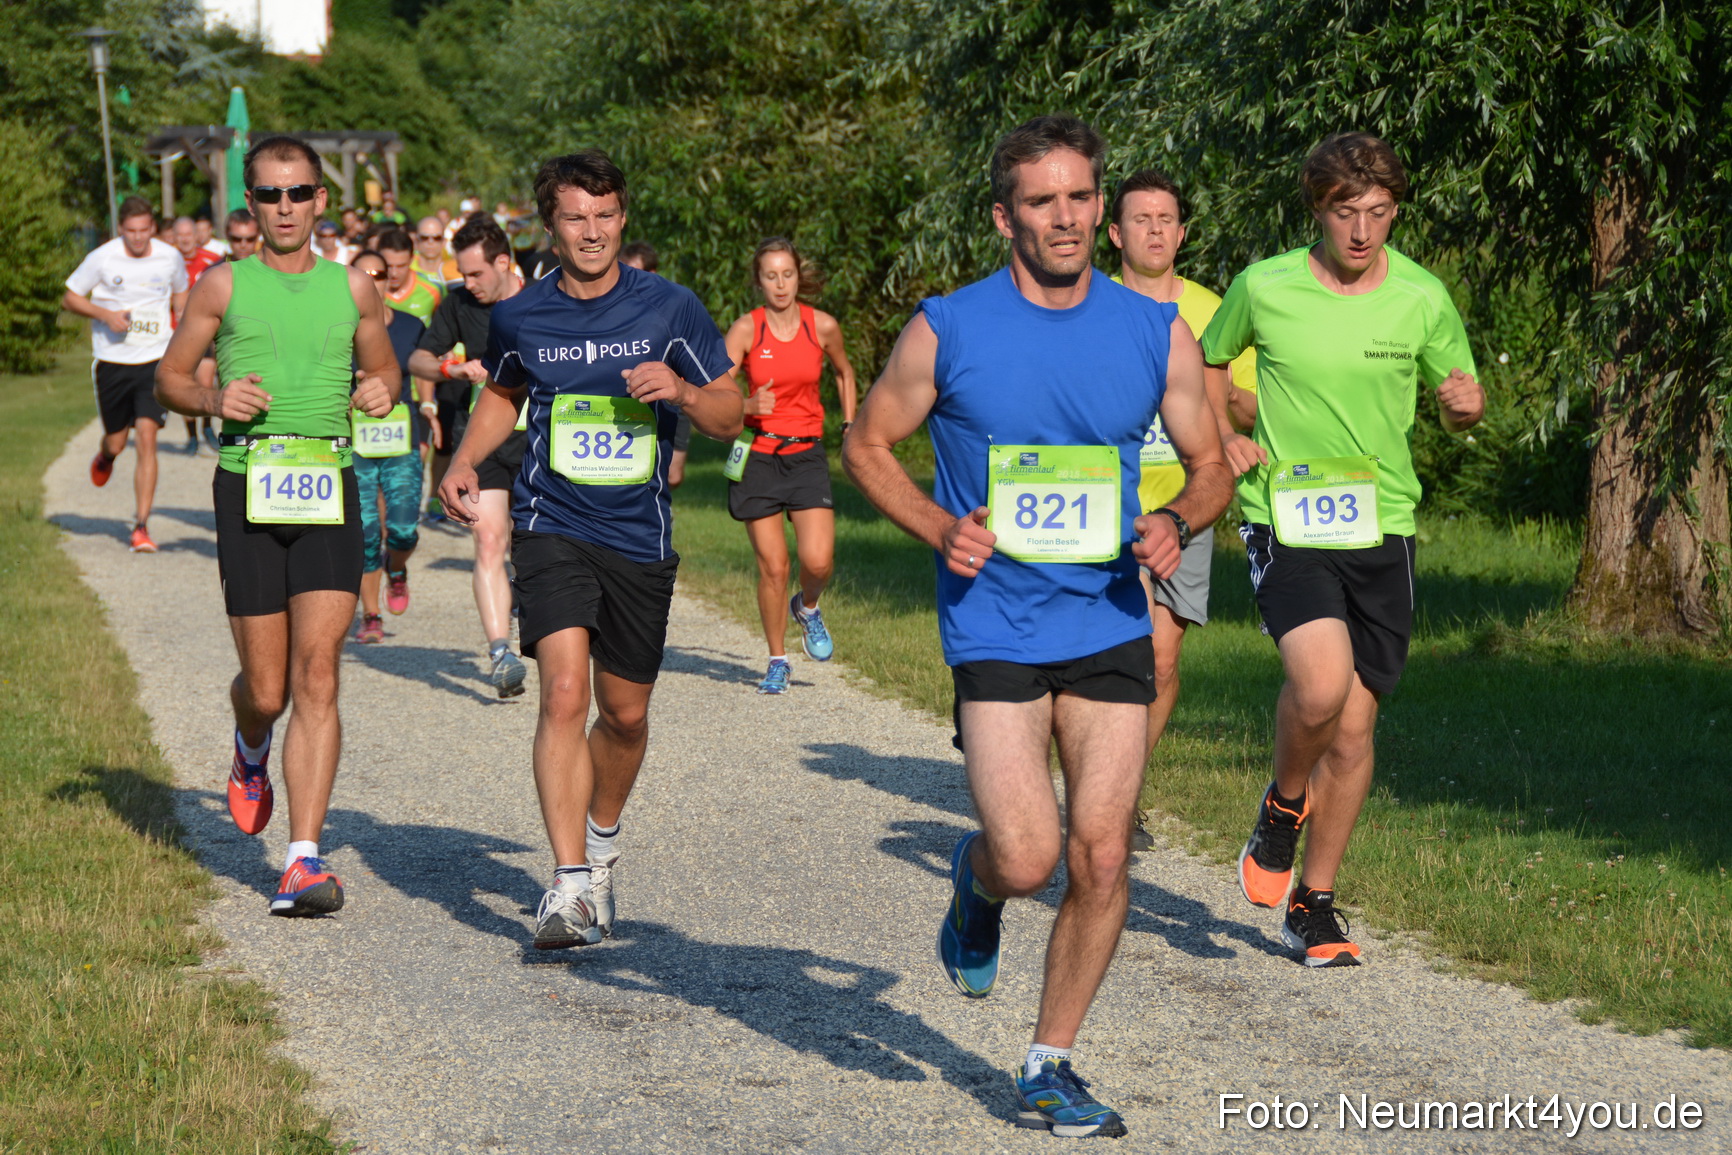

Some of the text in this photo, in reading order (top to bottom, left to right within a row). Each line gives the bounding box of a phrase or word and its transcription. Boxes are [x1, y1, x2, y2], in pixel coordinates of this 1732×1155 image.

[1372, 338, 1388, 347] Team
[538, 339, 651, 363] EURO POLES
[1364, 350, 1413, 361] SMART POWER
[359, 425, 405, 443] 1294
[571, 430, 634, 460] 382
[1009, 464, 1056, 474] firmenlauf
[1286, 472, 1324, 482] firmenlauf
[259, 472, 333, 501] 1480
[1014, 492, 1088, 530] 821
[1294, 493, 1359, 527] 193
[1303, 529, 1355, 539] Alexander Braun
[1026, 538, 1080, 546] Florian Bestle
